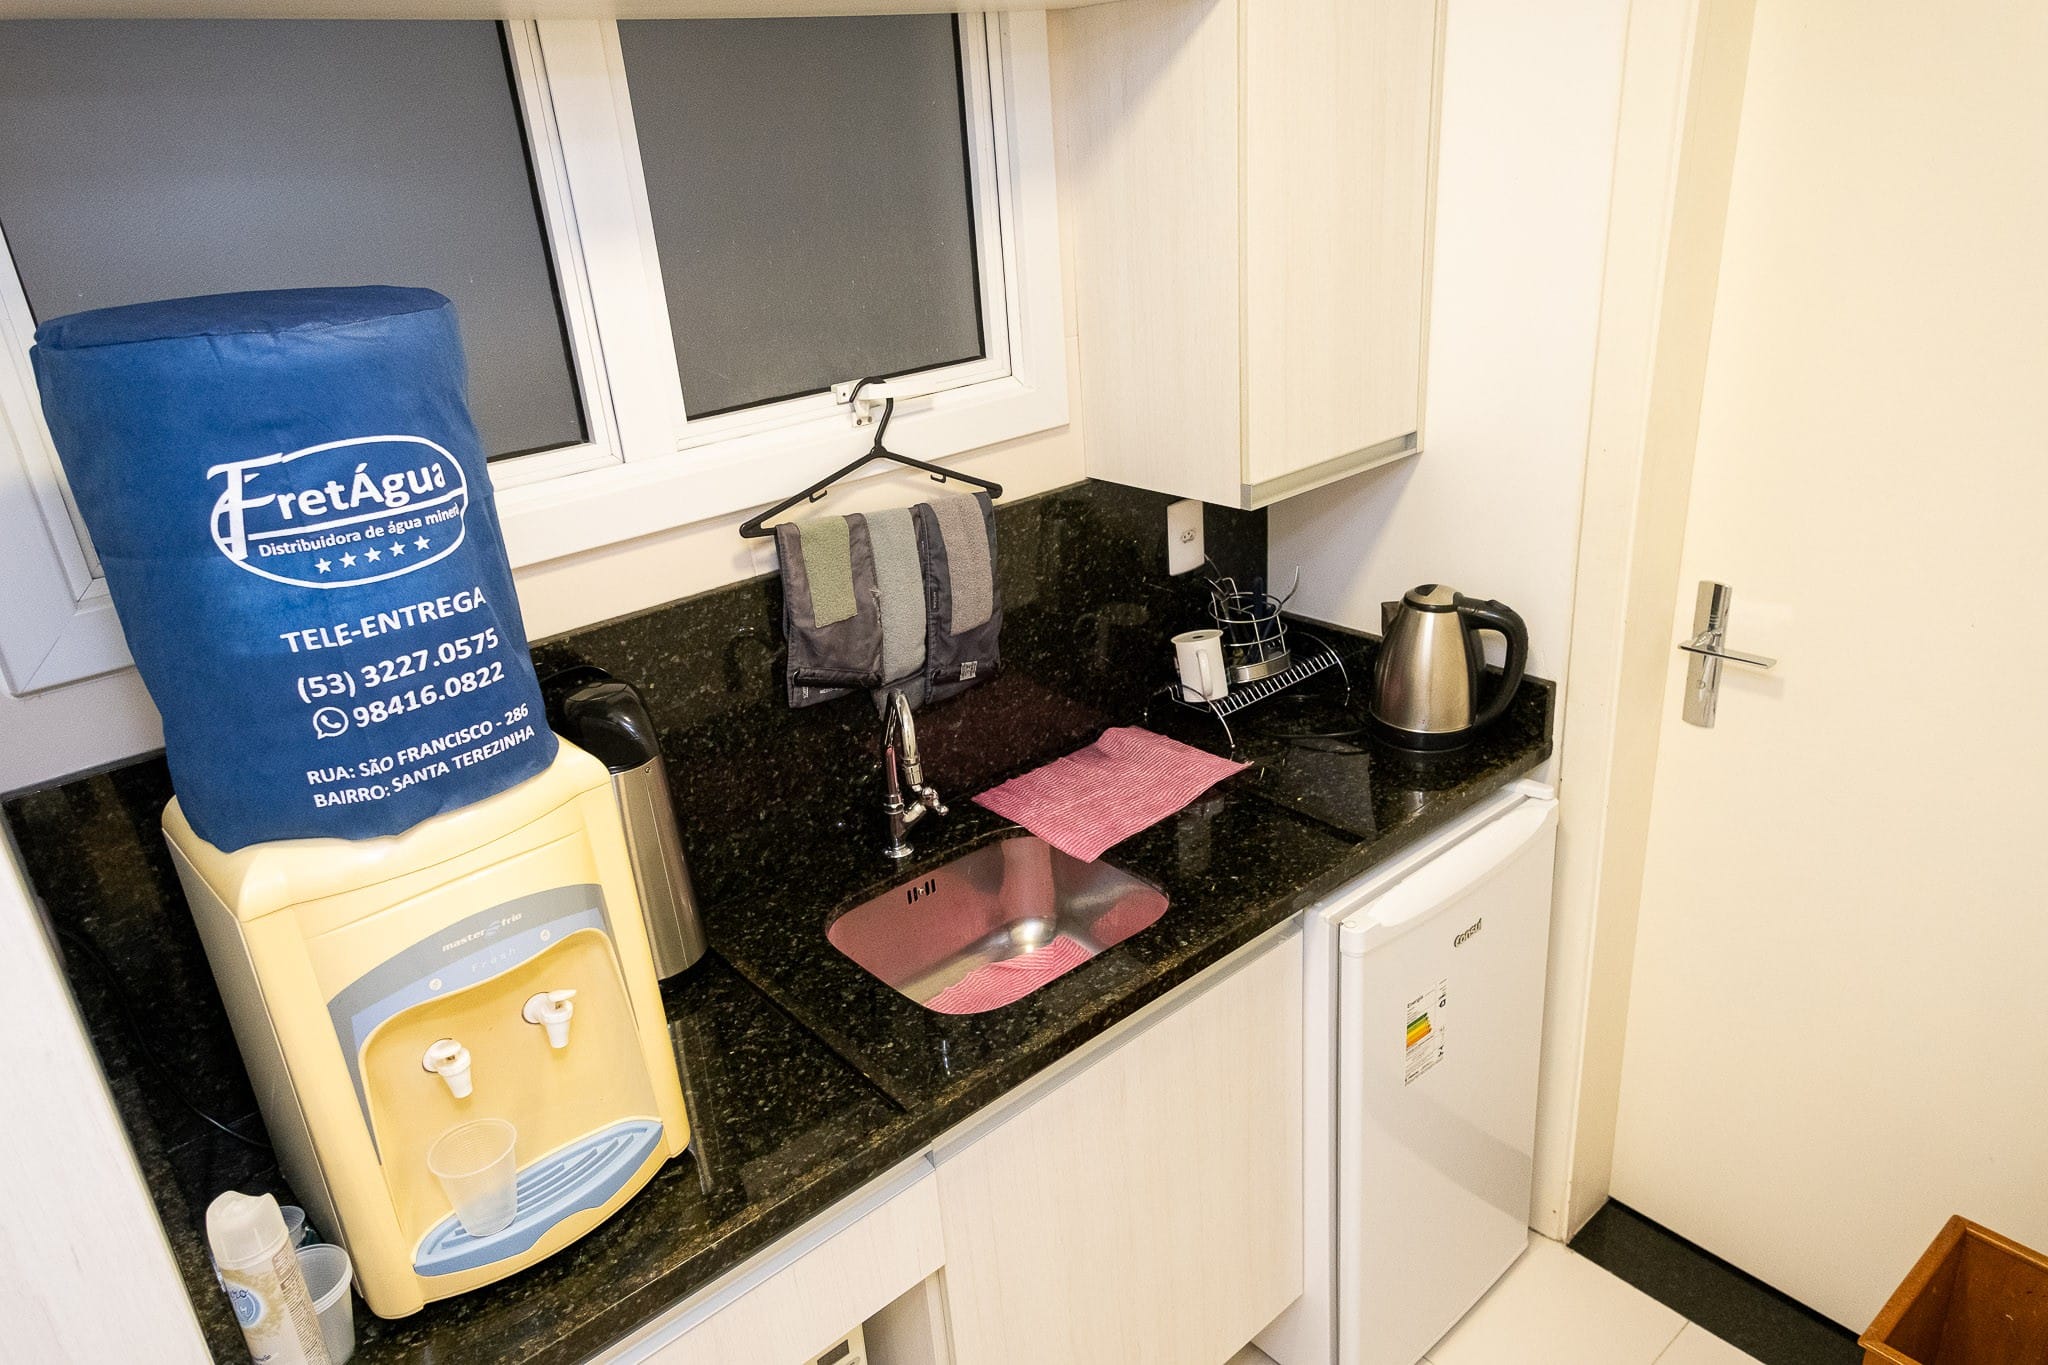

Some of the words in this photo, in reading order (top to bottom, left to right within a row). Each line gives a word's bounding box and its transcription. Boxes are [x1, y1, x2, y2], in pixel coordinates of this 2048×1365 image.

[207, 453, 446, 561] FretÁgua
[257, 530, 361, 558] Distribuidora
[365, 524, 386, 539] de
[387, 515, 423, 534] água
[280, 586, 487, 653] TELE-ENTREGA
[297, 670, 356, 704] (53)
[360, 627, 499, 688] 3227.0575
[352, 660, 505, 728] 98416.0822
[306, 765, 356, 785] RUA:
[359, 754, 394, 778] SÃO
[397, 719, 493, 766] FRANCISCO
[504, 703, 529, 726] 286
[313, 784, 390, 808] BAIRRO:
[391, 764, 450, 793] SANTA
[452, 725, 535, 771] TEREZINHA
[442, 928, 487, 952] master
[501, 913, 523, 926] frio
